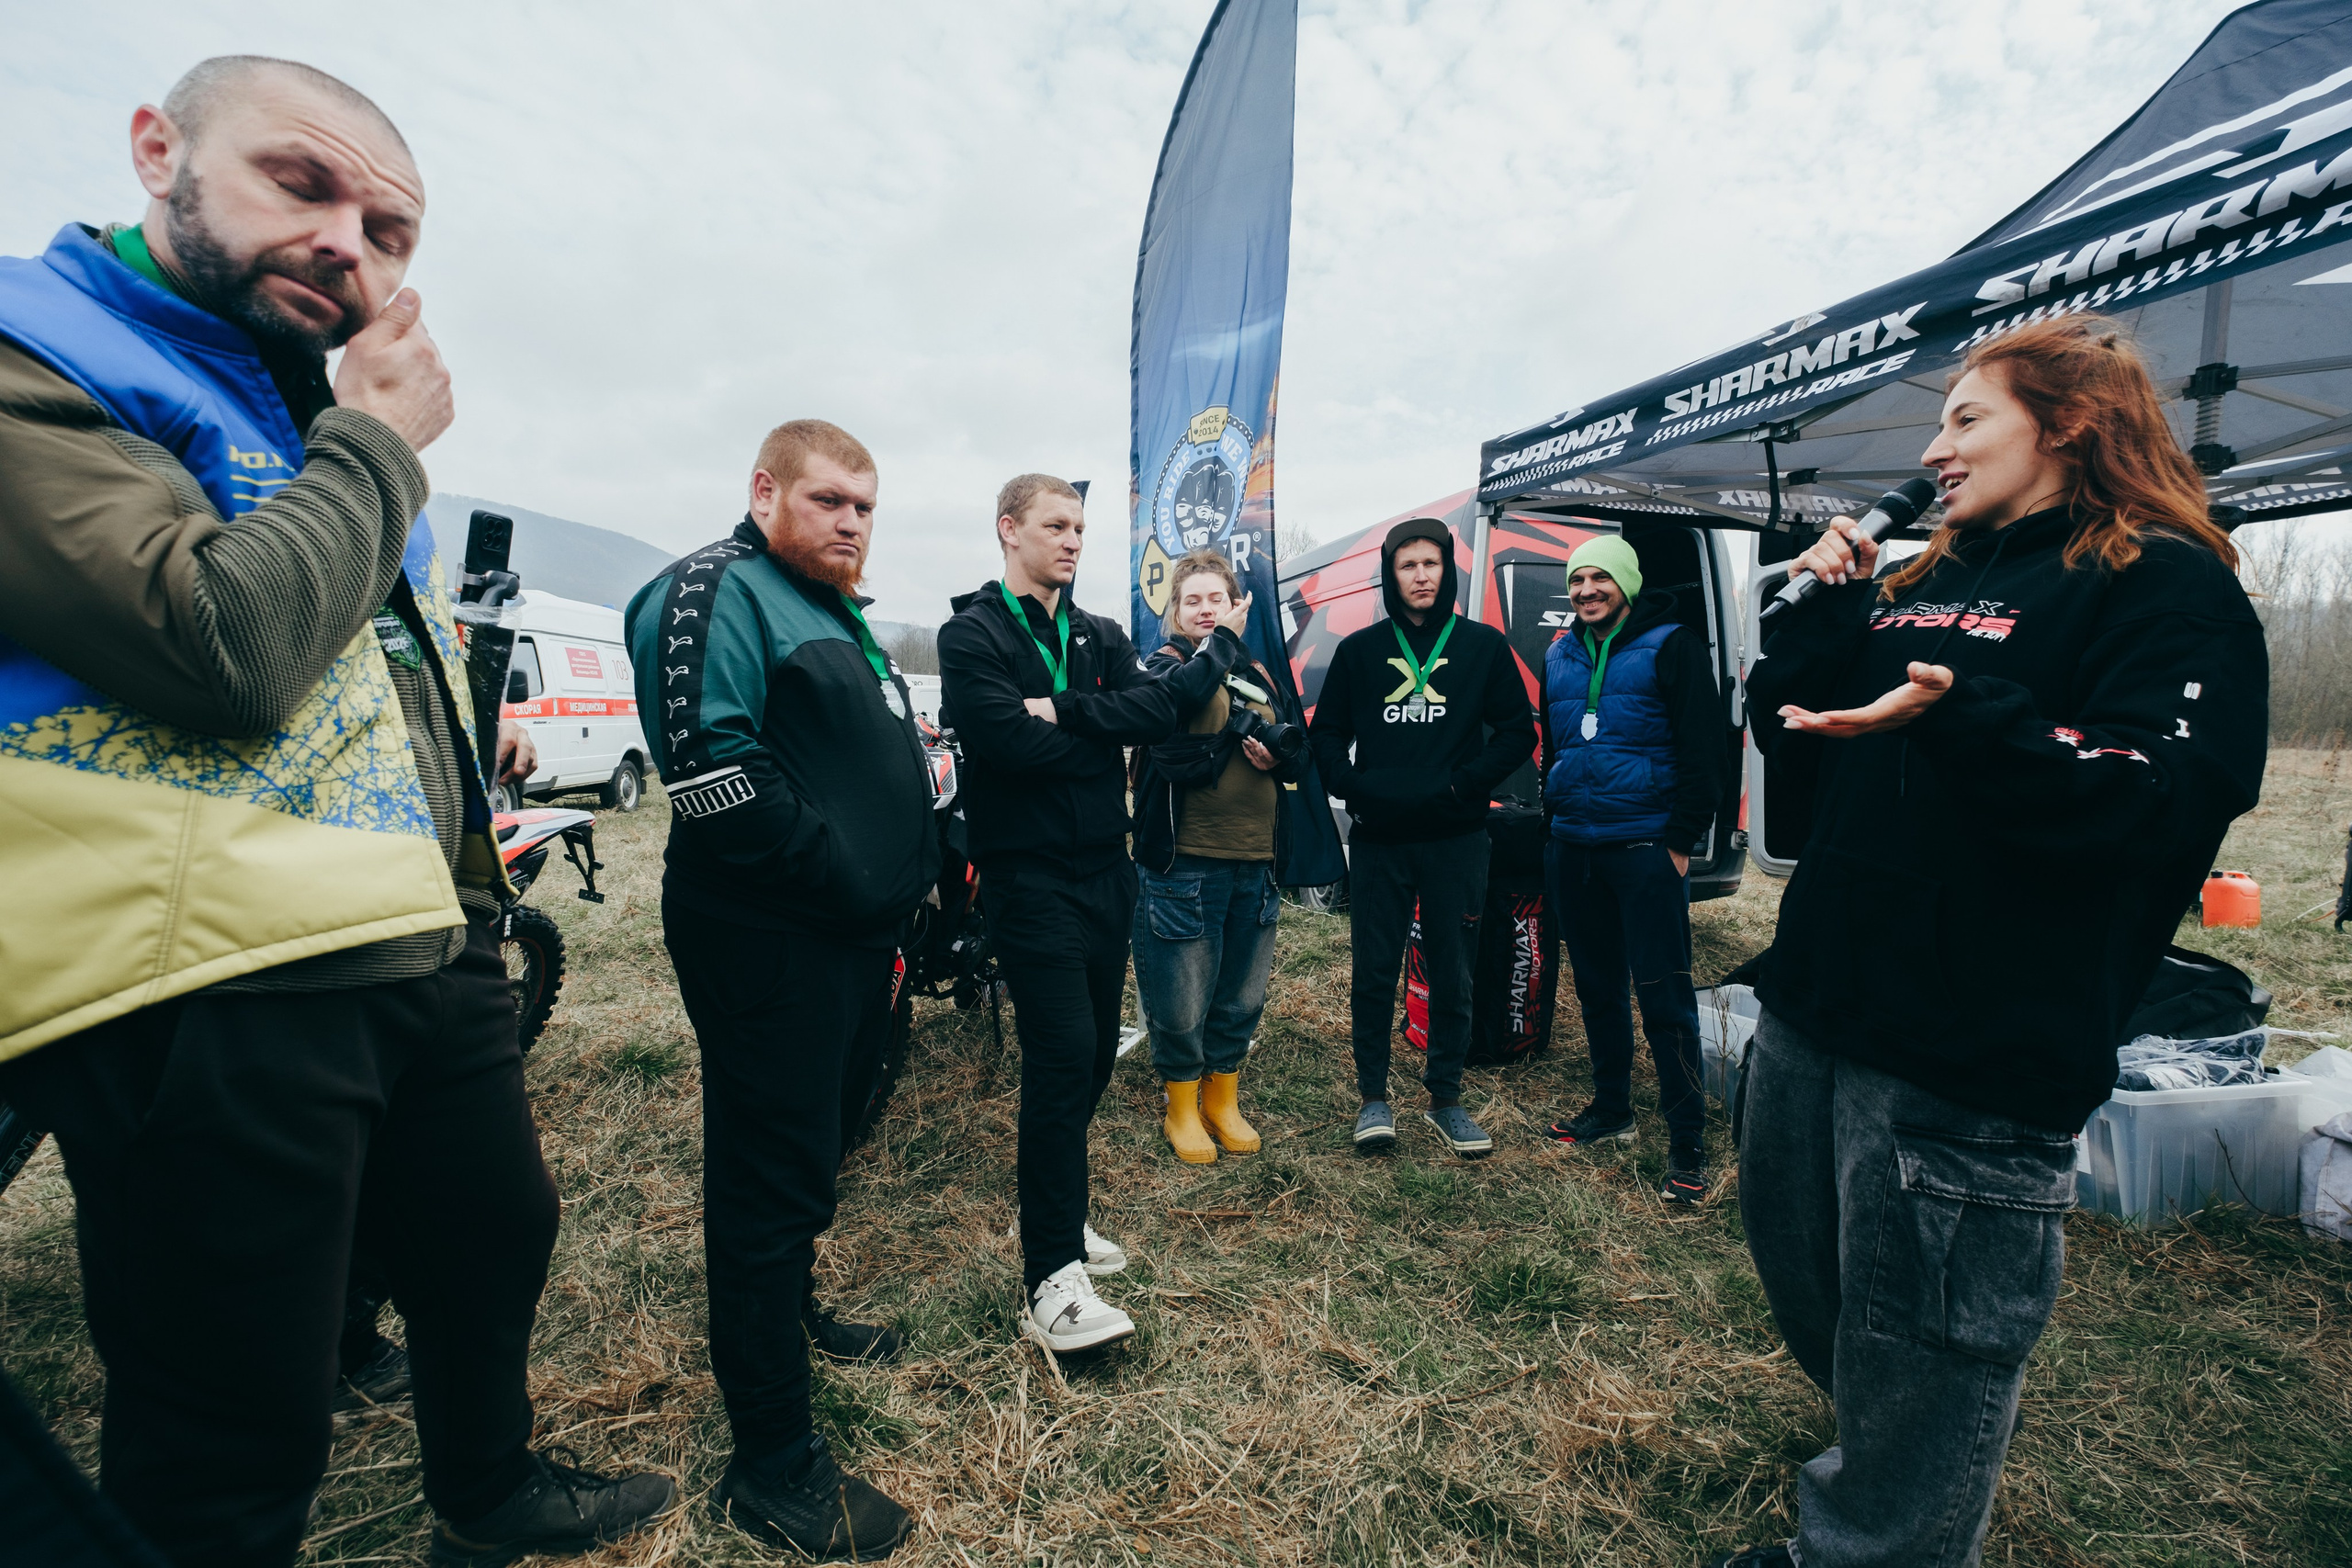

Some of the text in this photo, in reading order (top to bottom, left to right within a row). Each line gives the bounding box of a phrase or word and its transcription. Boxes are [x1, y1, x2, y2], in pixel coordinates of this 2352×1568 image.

[1660, 301, 1928, 423] SHARMAX
[1802, 350, 1917, 399] RACE
[1198, 426, 1218, 437] 2014
[1220, 434, 1243, 462] WE
[1489, 408, 1638, 477] SHARMAX
[1568, 440, 1626, 469] RACE
[1163, 450, 1191, 501] RIDE
[1160, 506, 1176, 551] YOU
[612, 659, 629, 681] 103
[514, 704, 542, 716] СКОРАЯ
[570, 702, 606, 714] МЕДИЦИНСКАЯ
[670, 773, 756, 821] PUMA
[1529, 918, 1541, 980] MOTORS
[1508, 917, 1532, 1034] SHARMAX
